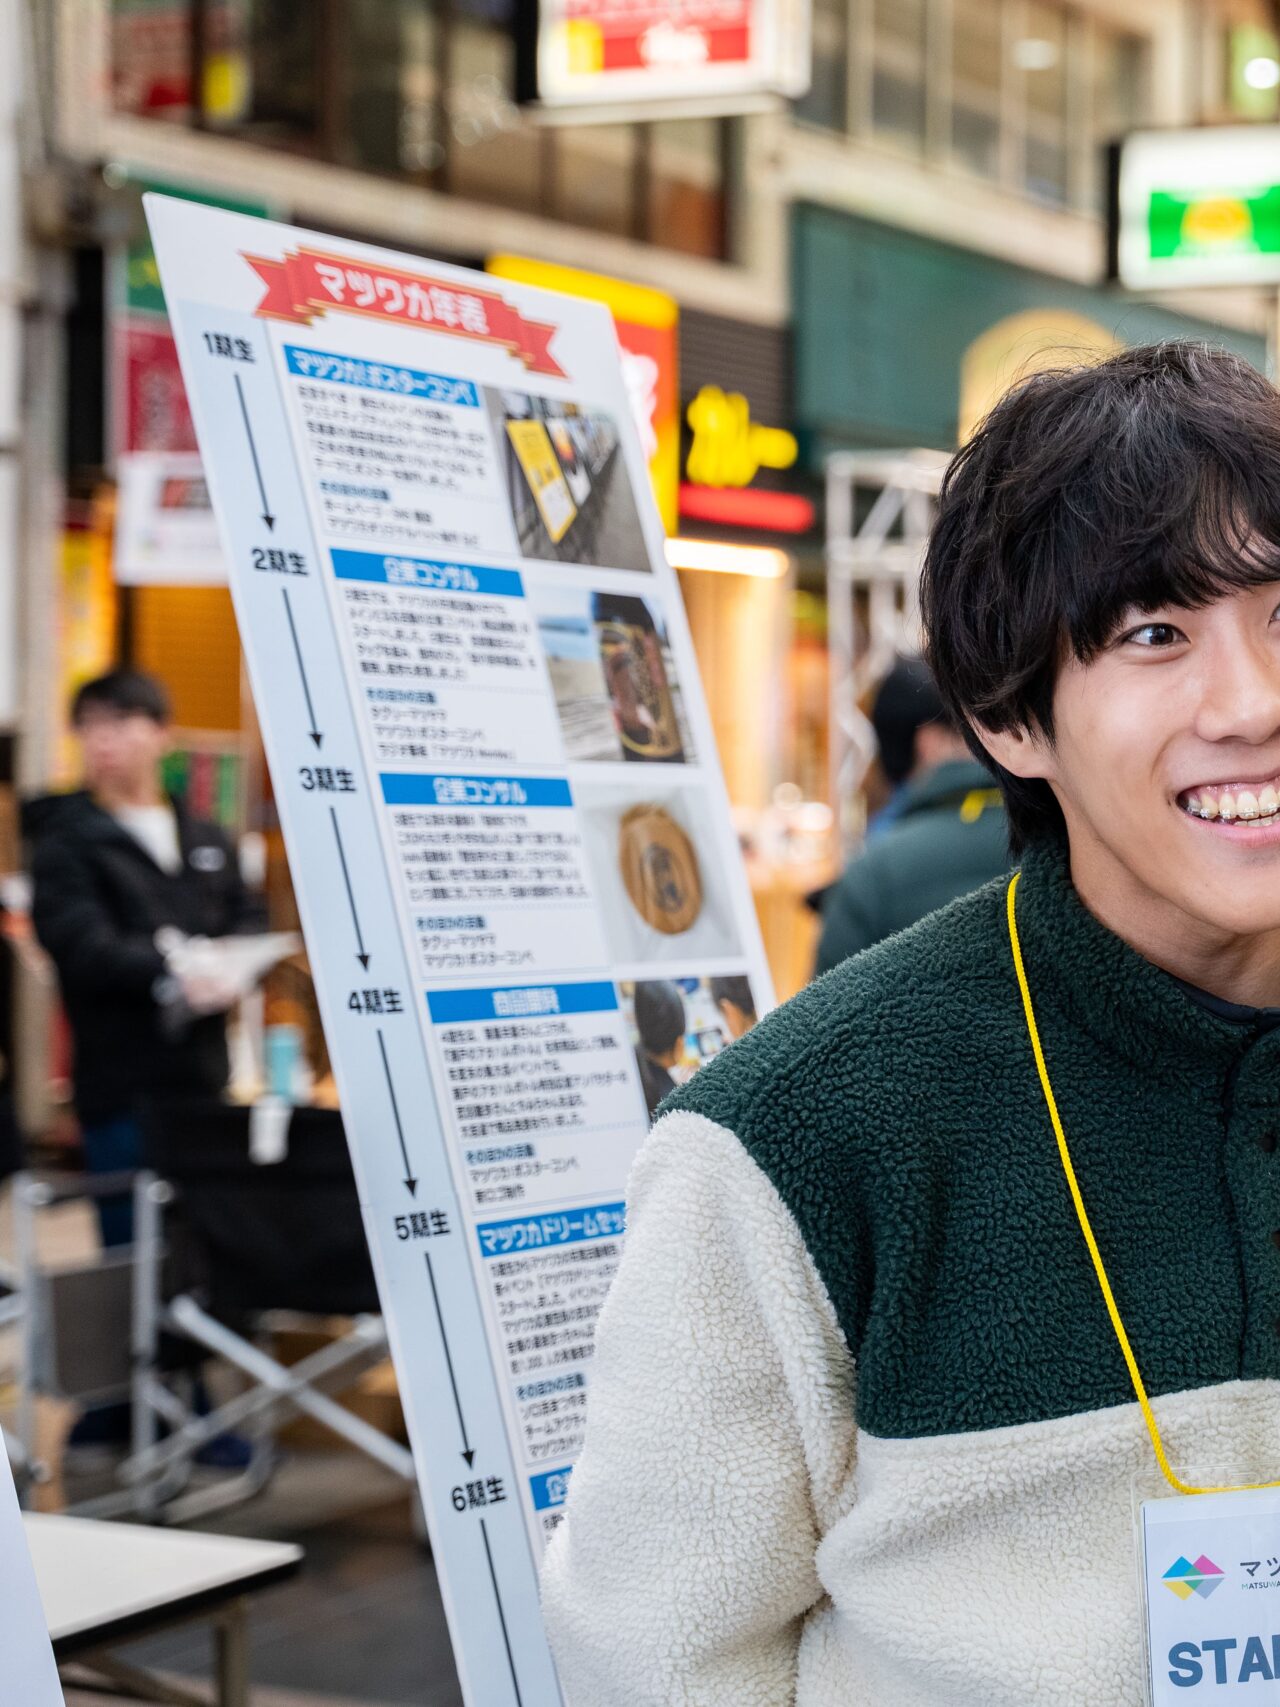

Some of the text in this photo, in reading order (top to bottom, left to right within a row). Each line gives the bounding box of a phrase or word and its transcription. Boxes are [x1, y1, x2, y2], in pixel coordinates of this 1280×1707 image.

[315, 262, 491, 335] マツワカ年表
[203, 331, 255, 364] 1期生
[251, 548, 308, 577] 2期生
[383, 557, 478, 591] 企業コンサル
[299, 767, 356, 792] 3期生
[434, 777, 528, 805] 企業コンサル
[348, 988, 404, 1014] 4期生
[394, 1210, 451, 1240] 5期生
[452, 1476, 507, 1512] 6期生
